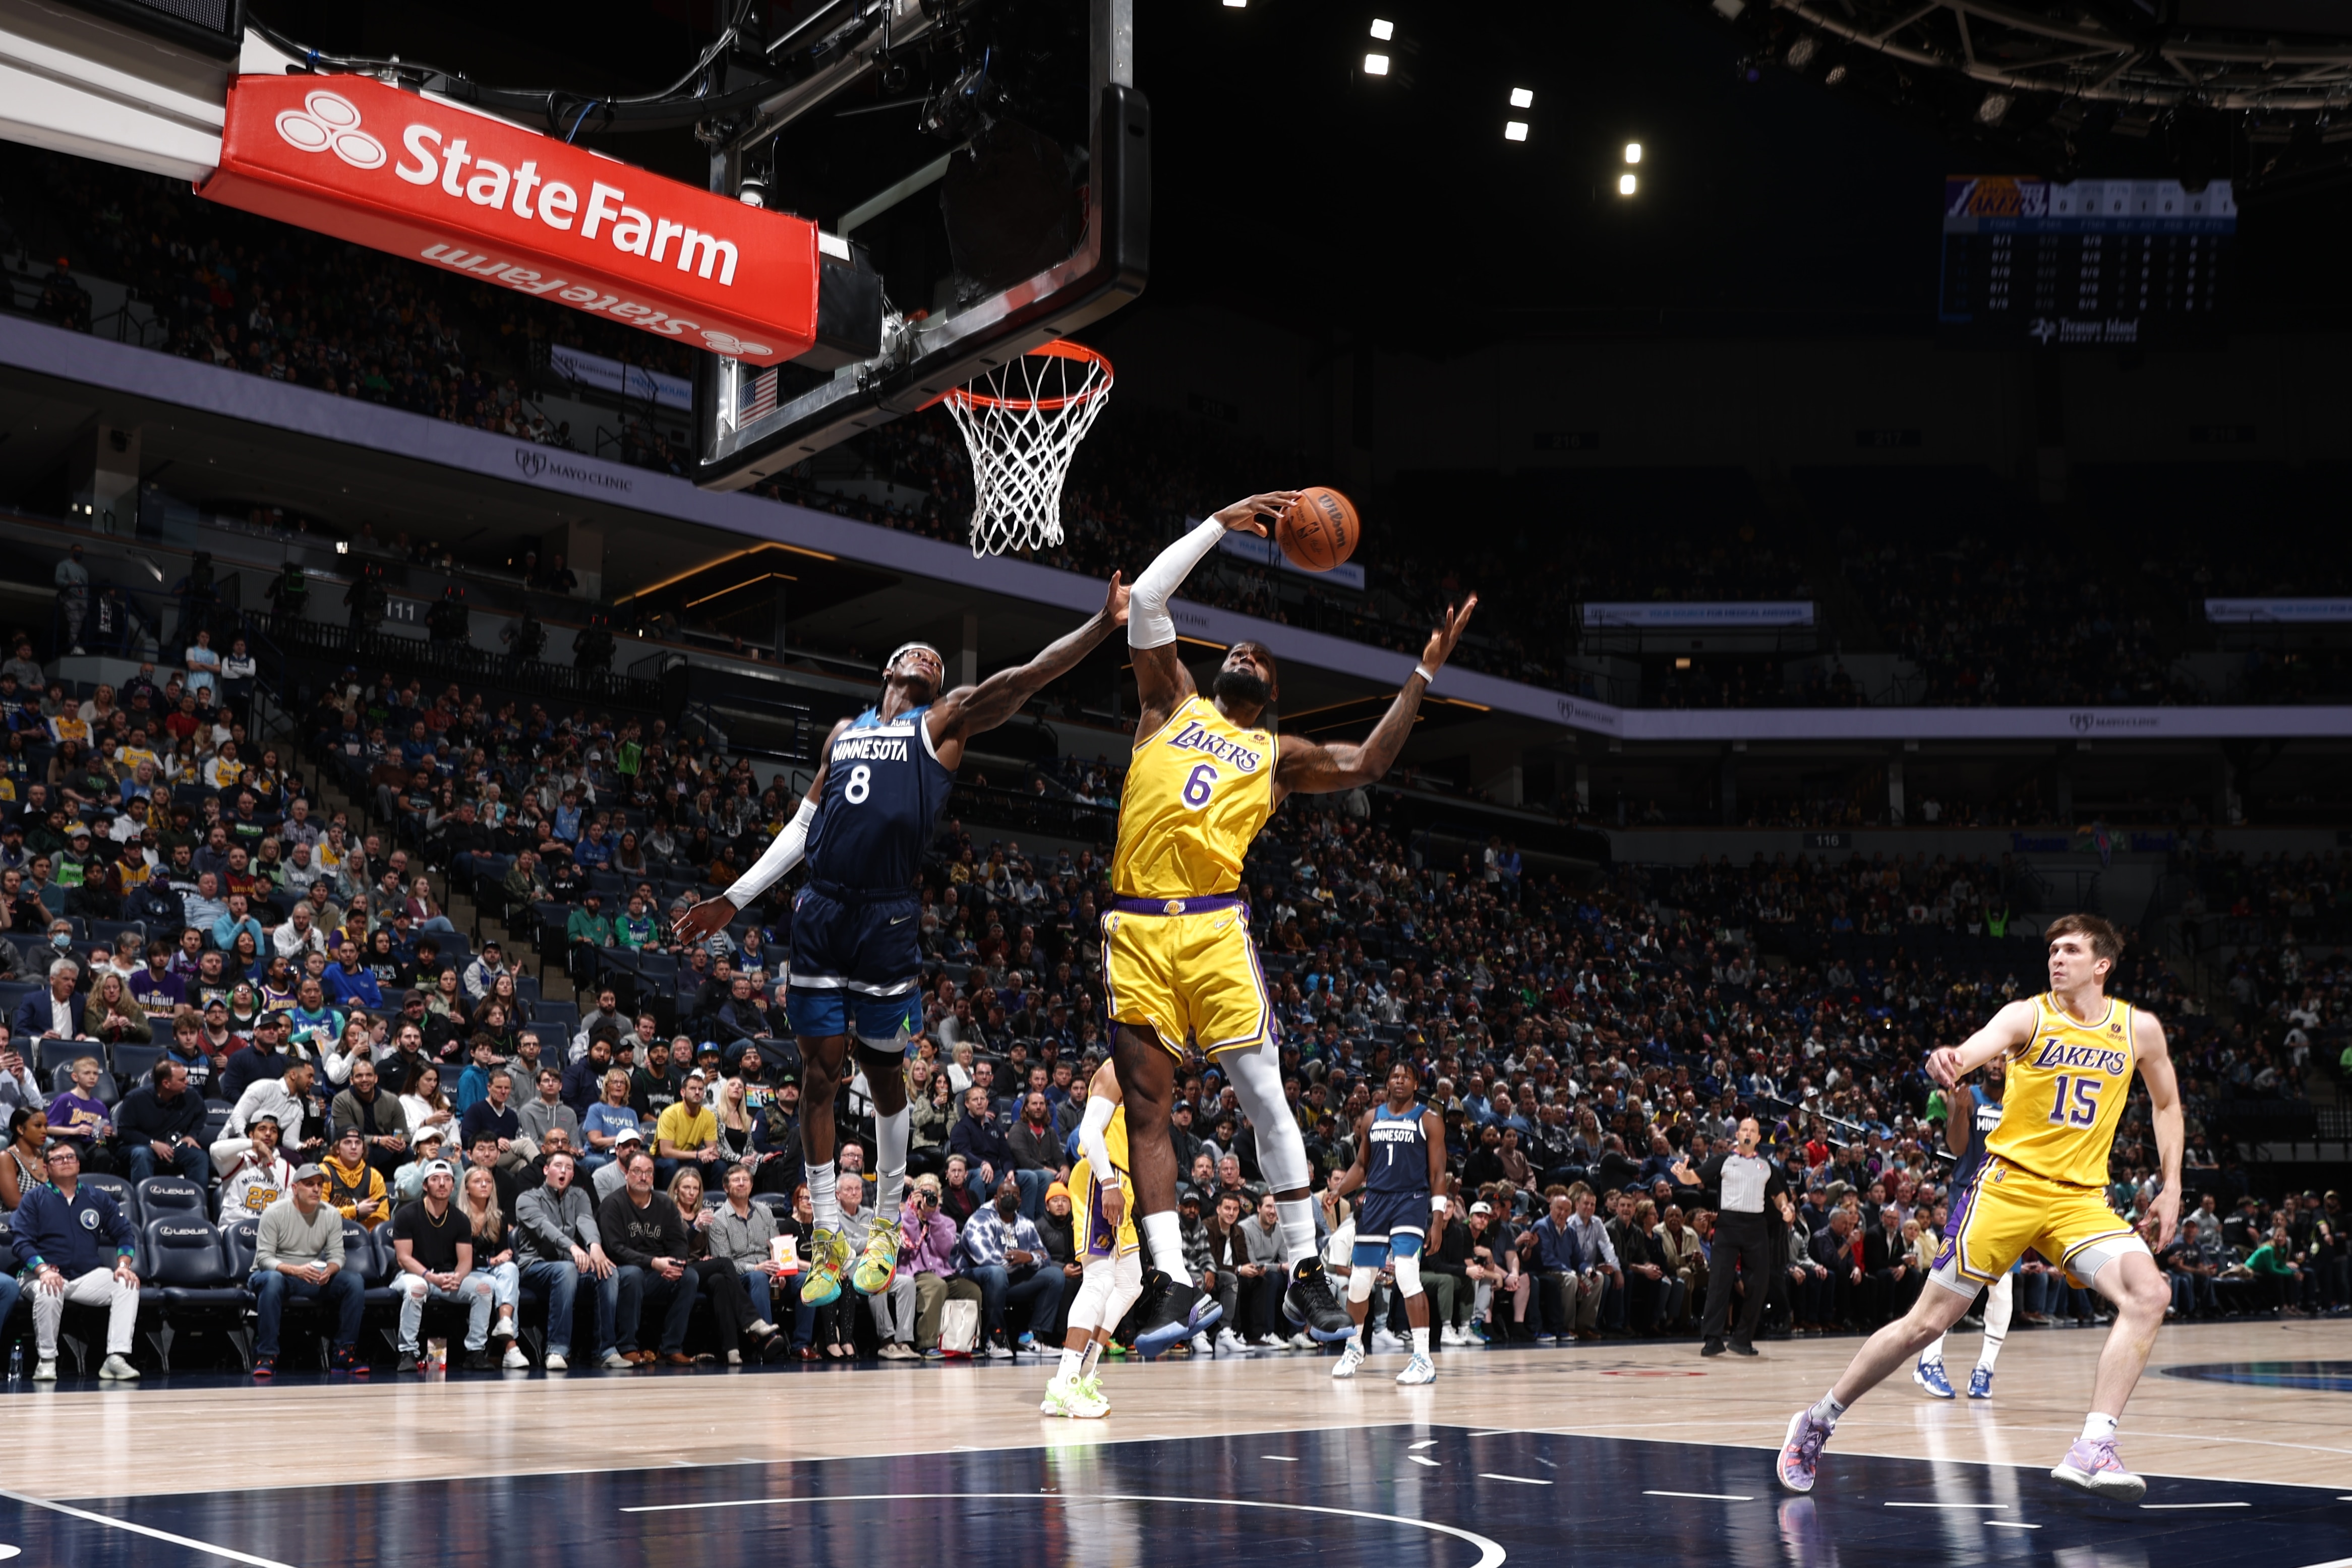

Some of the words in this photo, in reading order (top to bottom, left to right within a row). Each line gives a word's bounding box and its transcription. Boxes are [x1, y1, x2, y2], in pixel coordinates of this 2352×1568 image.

[550, 462, 586, 483] MAYO
[589, 471, 632, 493] CLINIC
[1318, 493, 1346, 548] Wilson
[387, 599, 415, 621] 111
[1179, 612, 1210, 629] CLINIC
[831, 738, 908, 764] MINNESOTA
[1166, 721, 1262, 774] LAKERS
[845, 764, 871, 805] 8
[1180, 763, 1220, 811] 6
[1815, 834, 1839, 848] 116
[2011, 832, 2069, 853] Treasure
[2131, 831, 2173, 853] Island
[629, 930, 649, 942] WOLVES
[139, 994, 150, 1005] NBA
[151, 996, 174, 1006] FINALS
[2106, 1032, 2127, 1043] bibigo
[2032, 1036, 2127, 1077] LAKERS
[2047, 1073, 2104, 1130] 15
[602, 1115, 634, 1128] WOLVES
[1369, 1129, 1415, 1143] MINNESOTA
[1386, 1143, 1393, 1166] 1
[246, 1186, 278, 1211] 22
